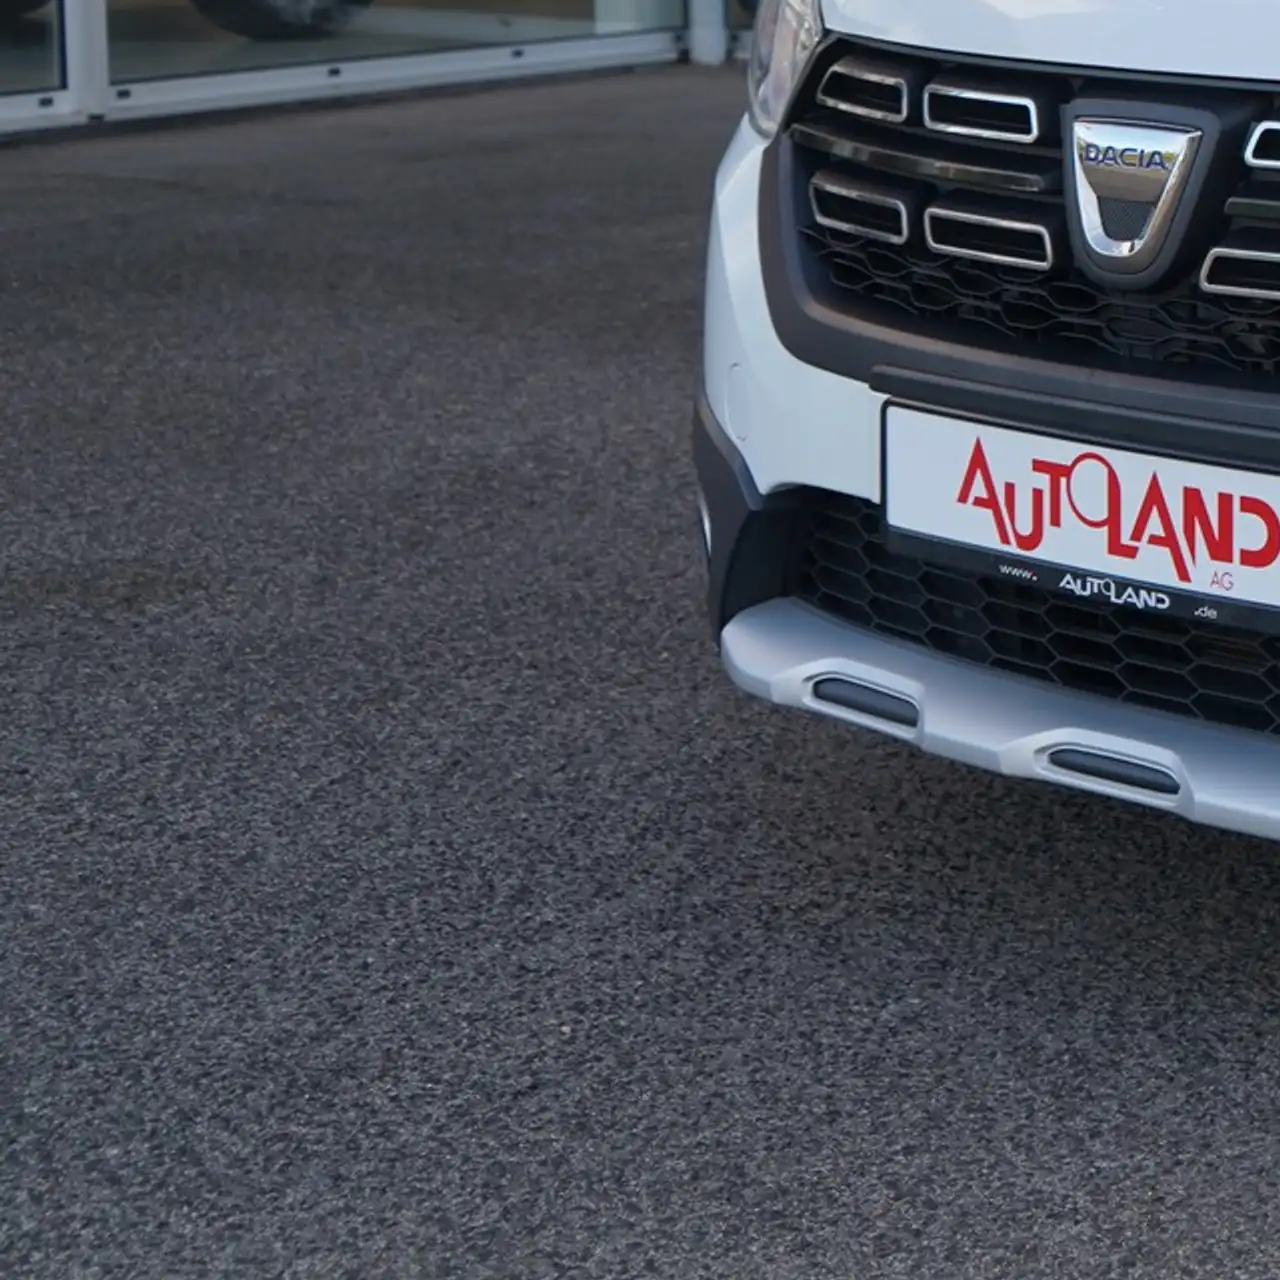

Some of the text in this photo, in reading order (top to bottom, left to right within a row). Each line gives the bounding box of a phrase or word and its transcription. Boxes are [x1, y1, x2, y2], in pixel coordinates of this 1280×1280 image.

[1083, 142, 1168, 170] DACIA
[1058, 573, 1170, 610] AUTOLAND
[1209, 570, 1234, 591] AG
